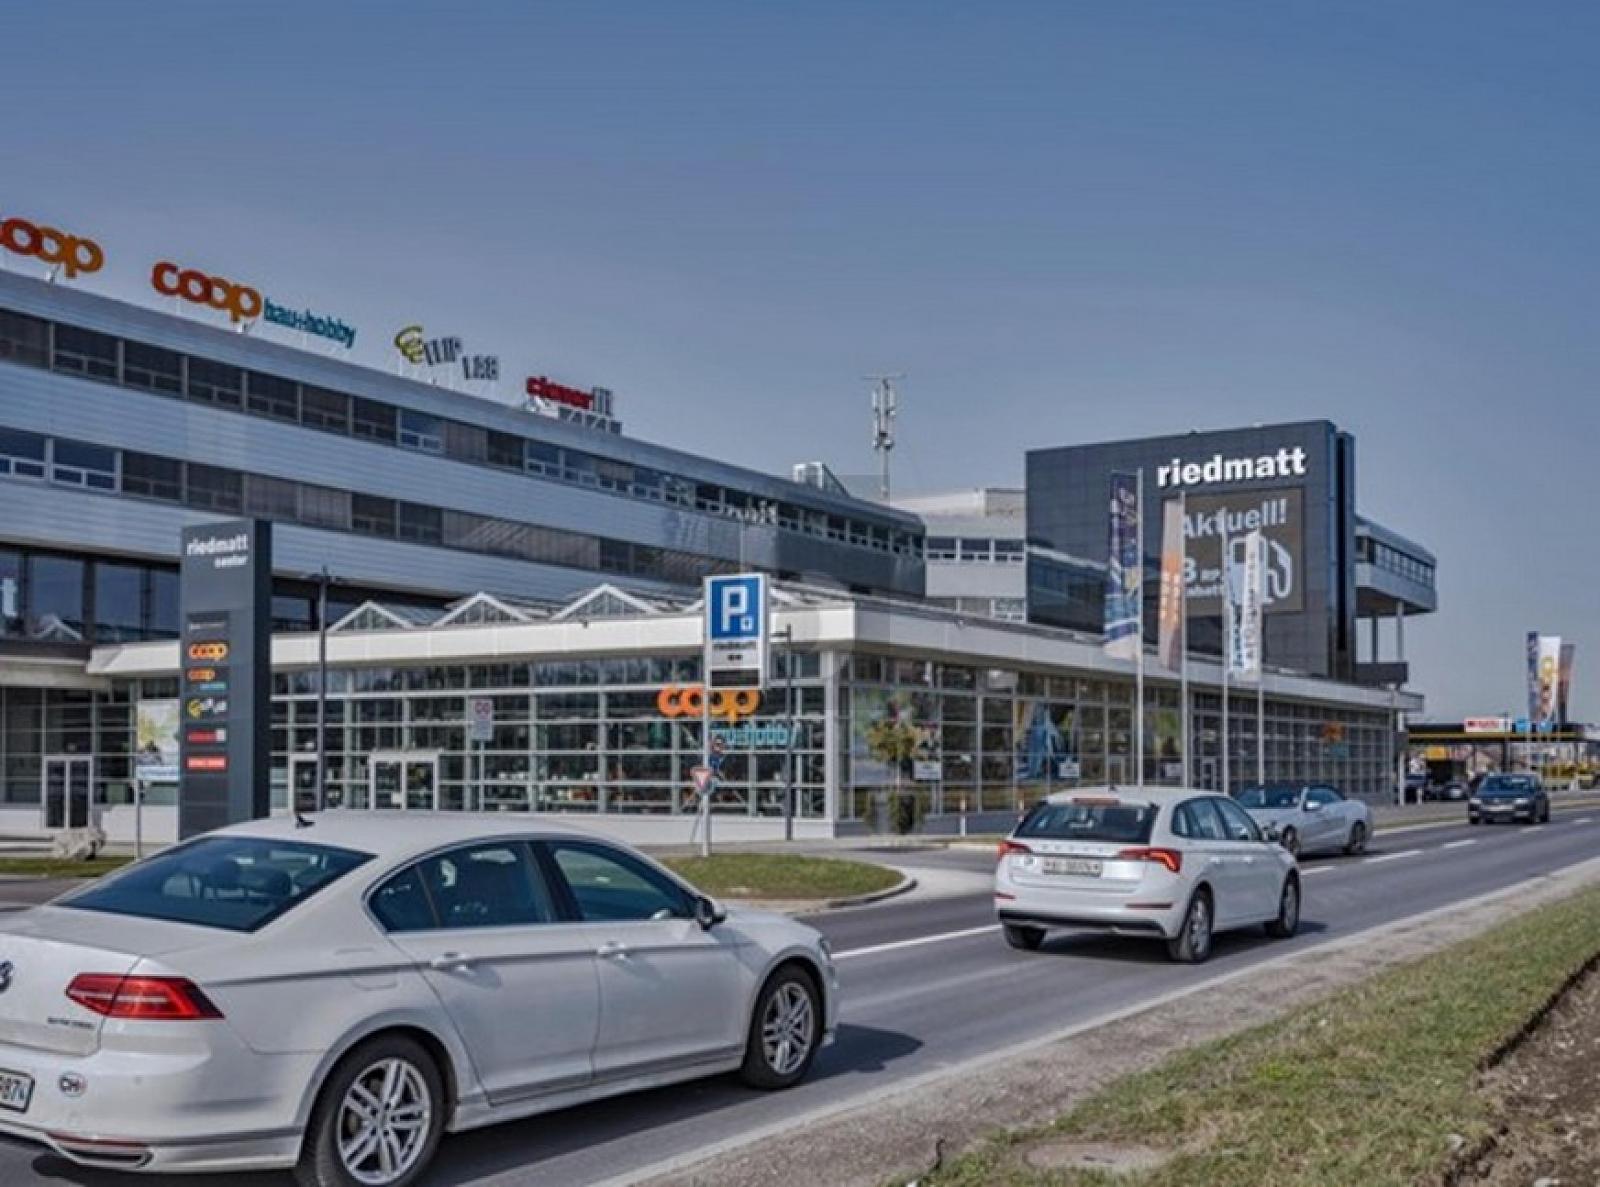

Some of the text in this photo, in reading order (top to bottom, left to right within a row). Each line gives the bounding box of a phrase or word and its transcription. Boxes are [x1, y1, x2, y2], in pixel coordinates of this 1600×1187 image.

[0, 218, 103, 278] oop
[152, 262, 261, 322] coop
[1157, 446, 1306, 488] riedmatt
[1183, 498, 1288, 539] Aktuell!
[187, 534, 248, 556] riedmatt
[721, 585, 749, 632] P
[657, 684, 761, 724] coop
